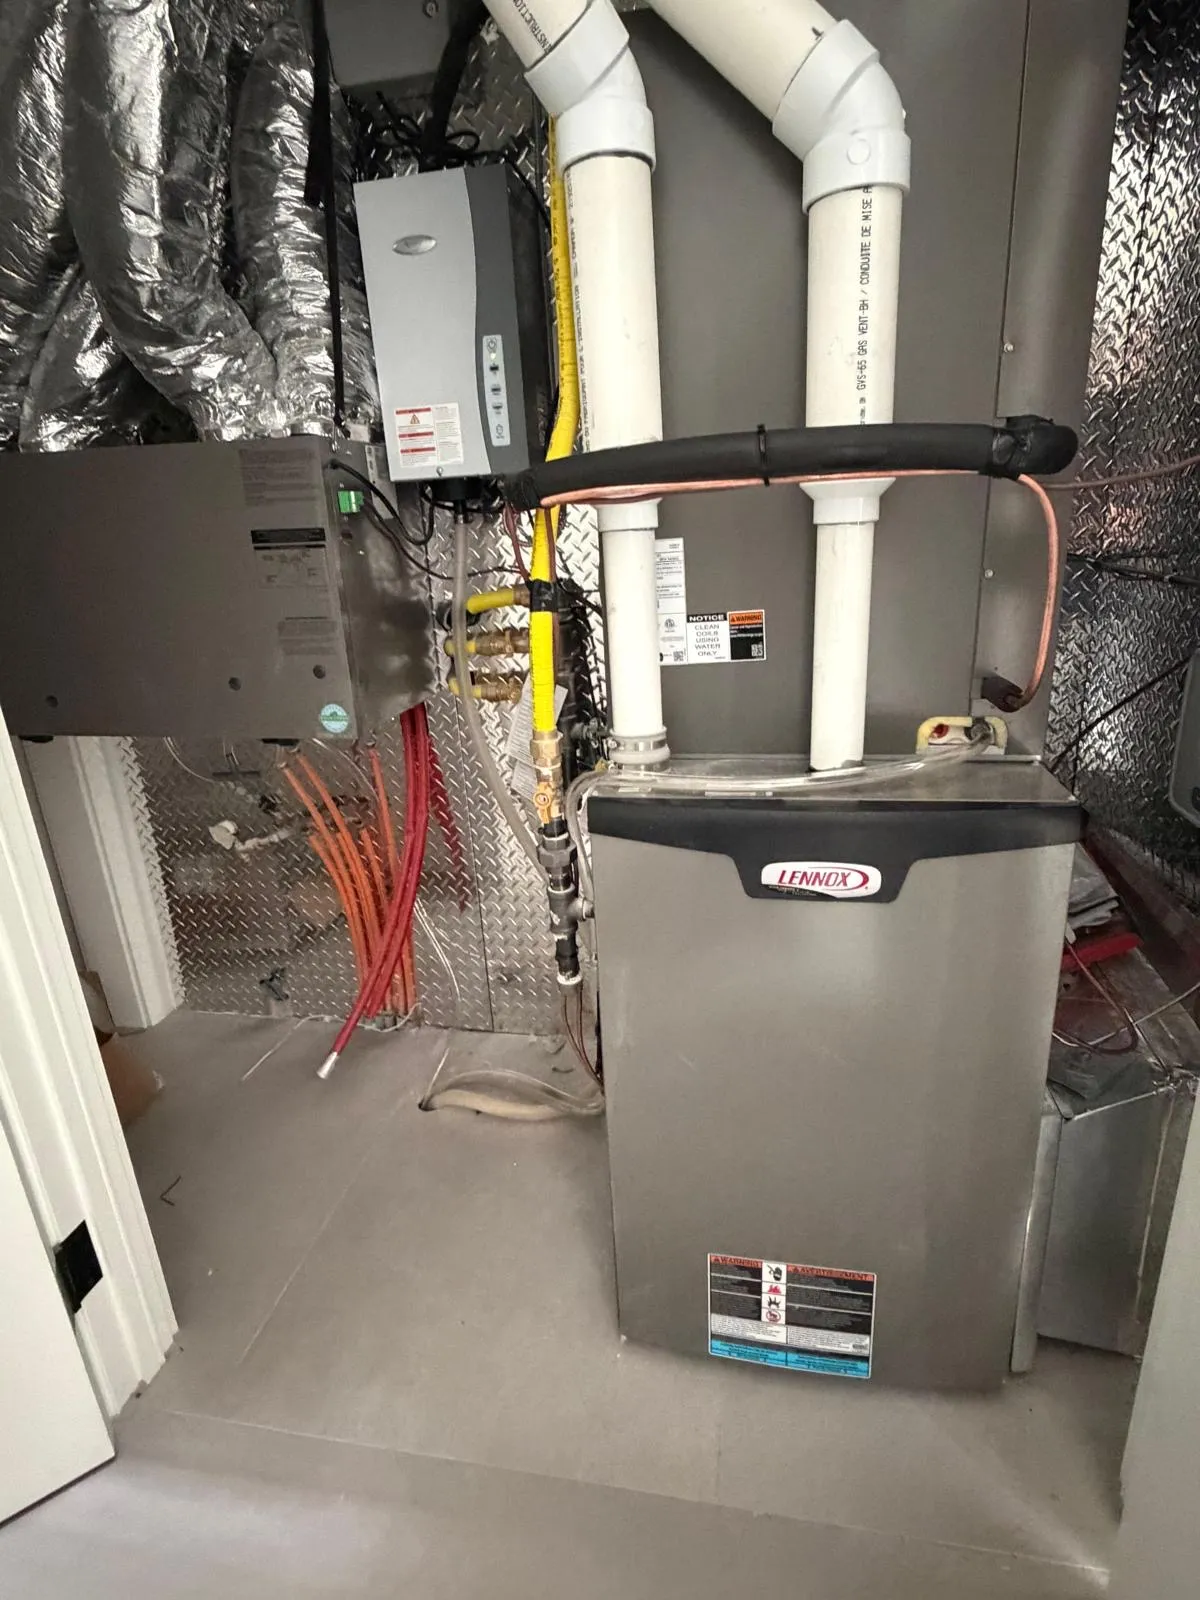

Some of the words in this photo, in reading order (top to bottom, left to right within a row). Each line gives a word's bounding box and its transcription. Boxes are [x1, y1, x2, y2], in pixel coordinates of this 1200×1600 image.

[513, 0, 552, 54] INSTRUCTIO
[861, 198, 873, 221] MISE
[861, 225, 872, 237] DE
[859, 240, 871, 285] CONDUITE
[858, 299, 869, 336] VENT-BH
[857, 339, 868, 356] GAS
[856, 359, 867, 391] GVS-65
[689, 614, 724, 622] NOTICE
[777, 870, 852, 887] LENNOX
[720, 1256, 761, 1269] WARNING
